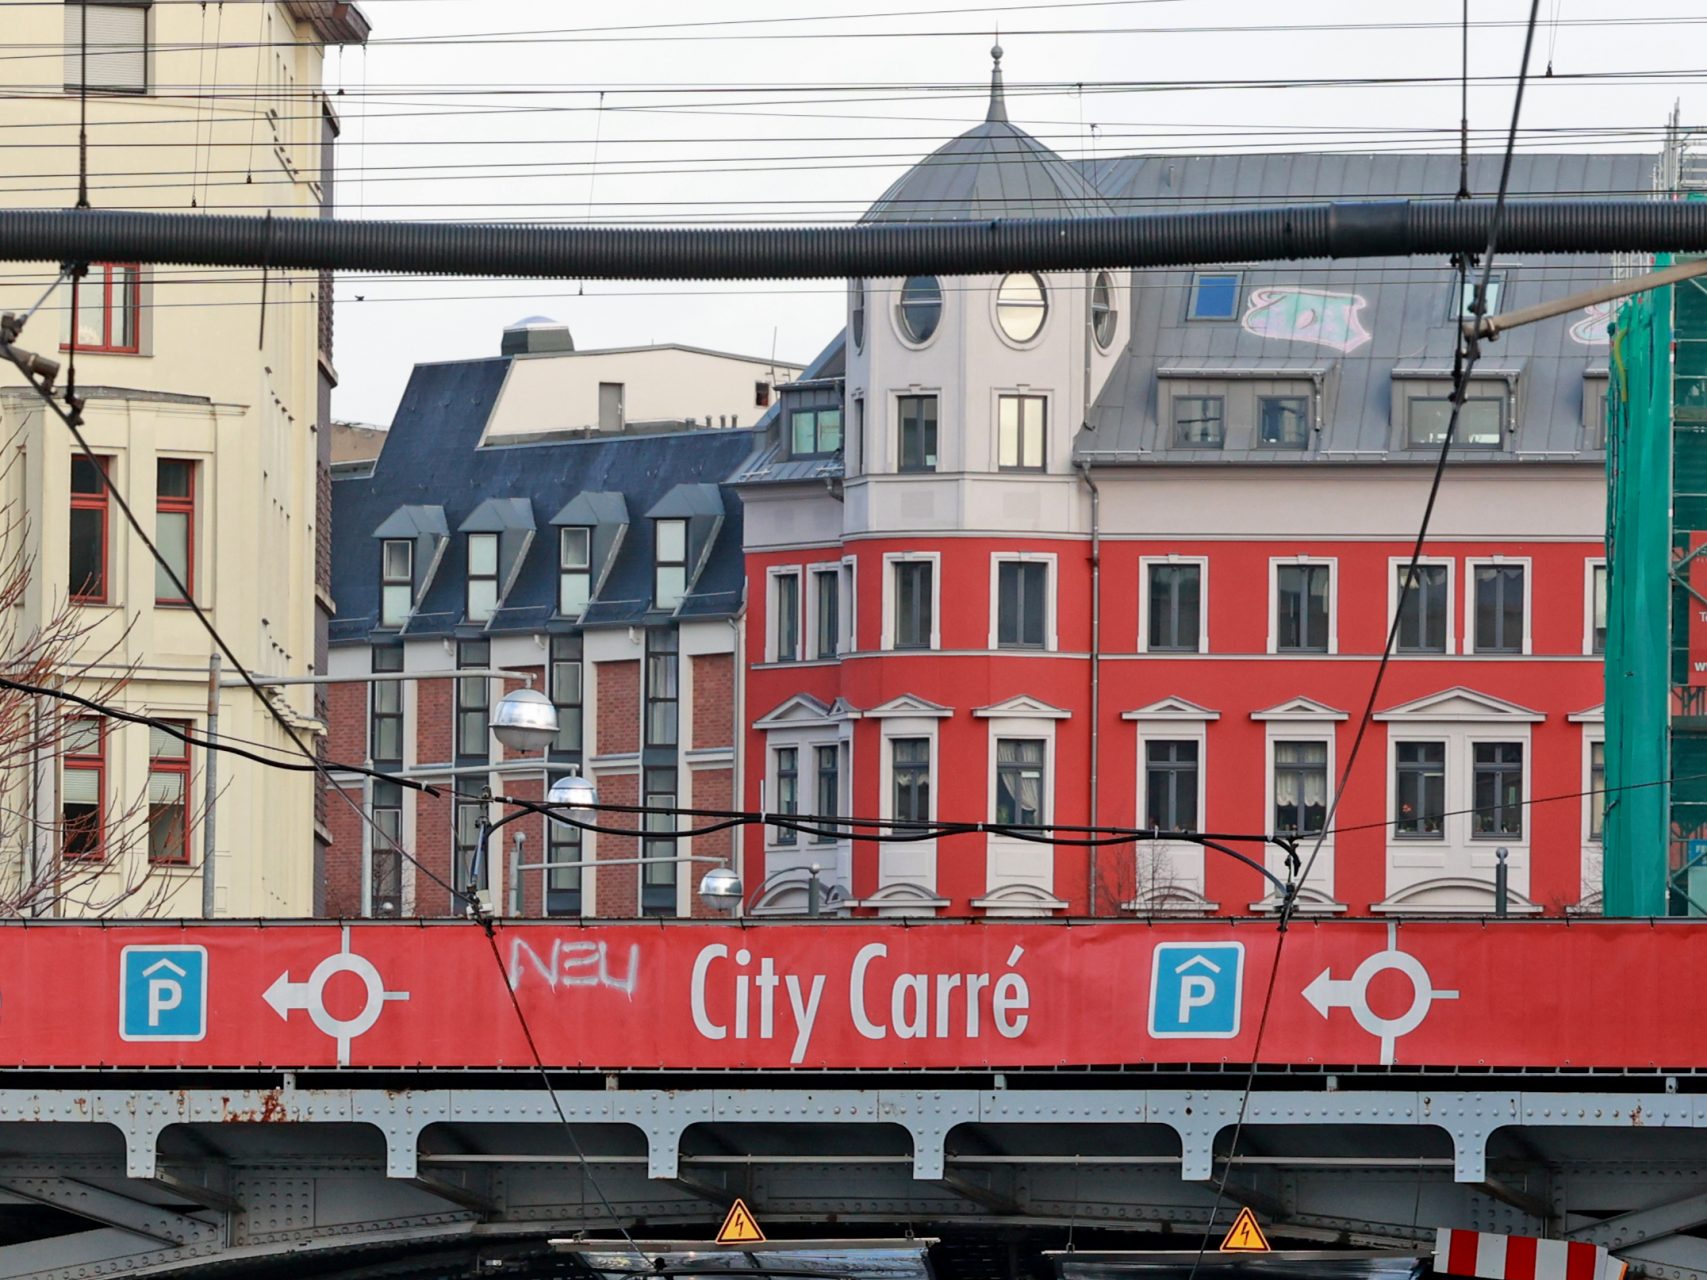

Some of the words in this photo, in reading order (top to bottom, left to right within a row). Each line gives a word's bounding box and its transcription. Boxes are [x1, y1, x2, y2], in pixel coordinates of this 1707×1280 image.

[148, 978, 183, 1027] P
[690, 943, 826, 1064] City
[849, 943, 1030, 1040] Carré
[1178, 975, 1216, 1023] P
